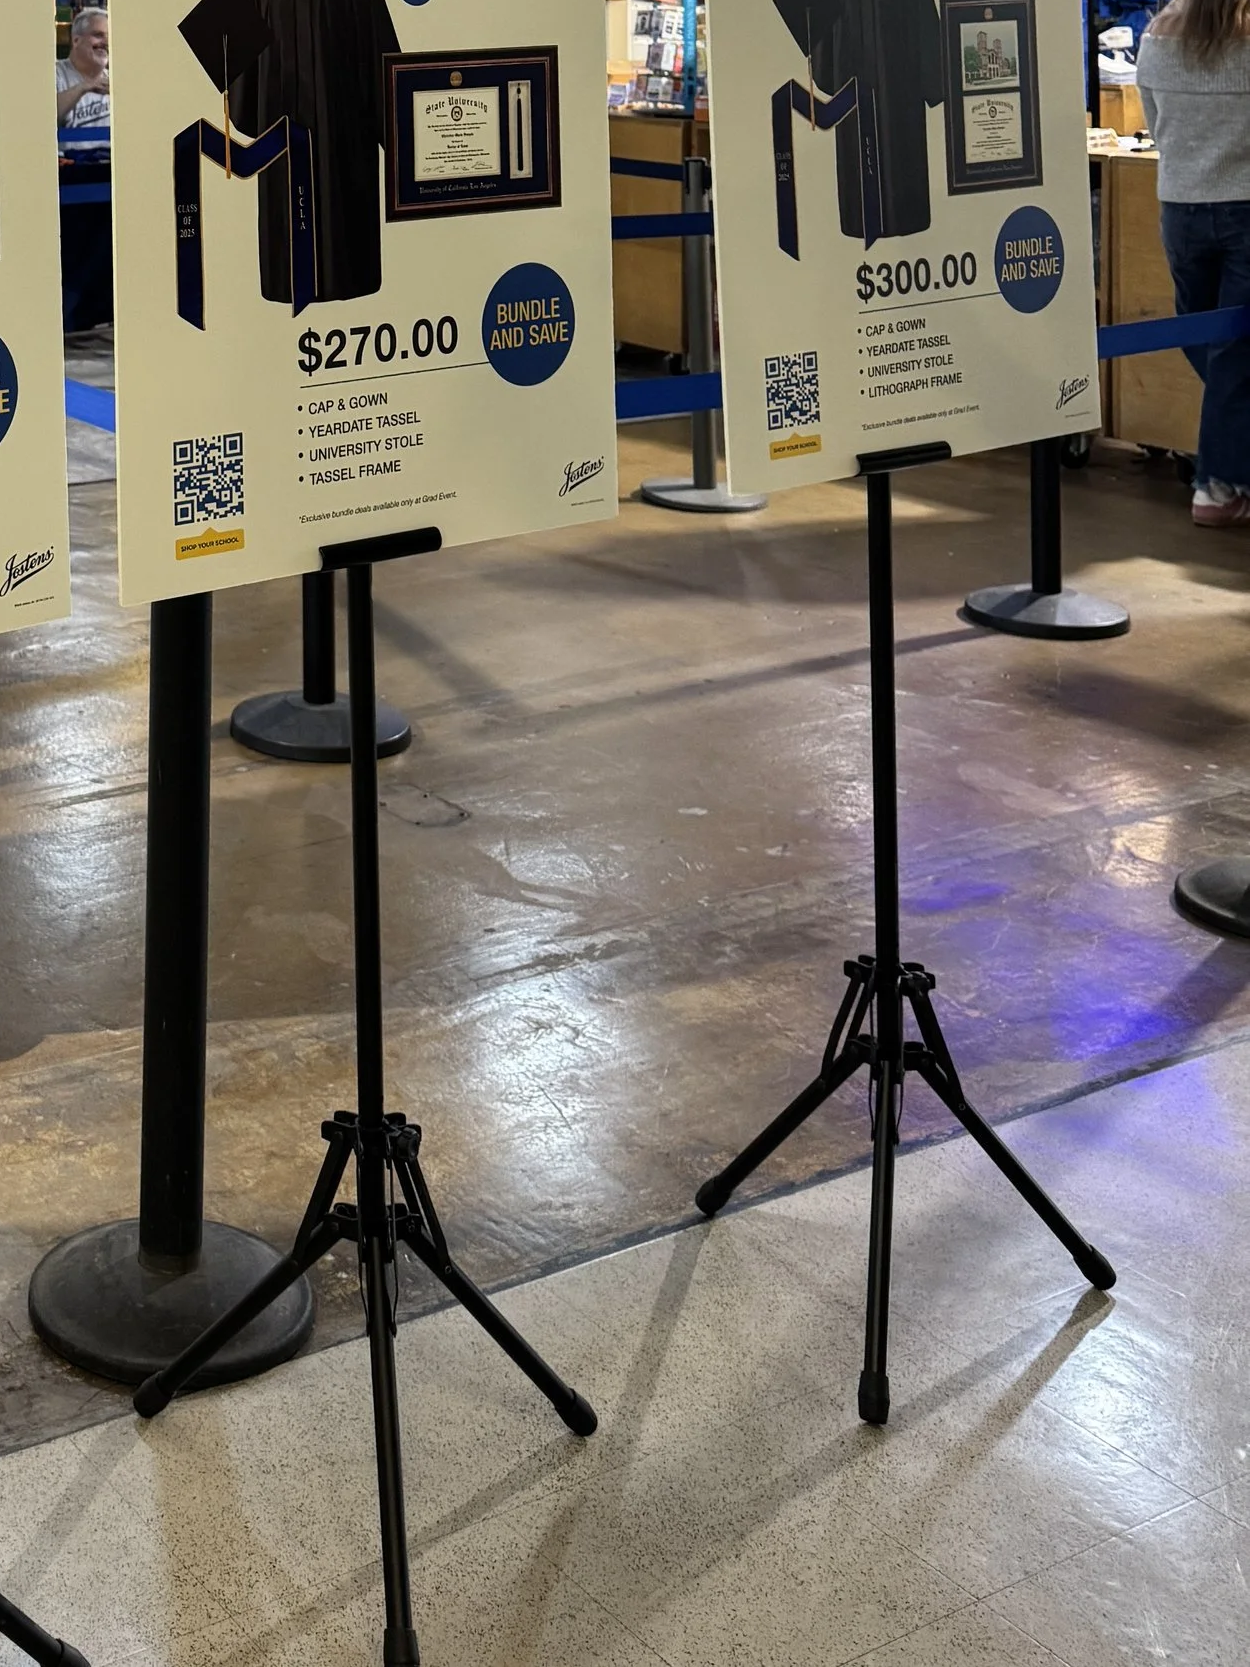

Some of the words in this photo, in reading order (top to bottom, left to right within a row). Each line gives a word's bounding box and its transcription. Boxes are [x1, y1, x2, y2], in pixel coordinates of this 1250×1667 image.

[177, 204, 198, 213] CLASS
[183, 216, 192, 225] OF
[298, 186, 306, 230] UCLA
[180, 229, 195, 238] 2025
[1005, 236, 1053, 259] BUNDLE
[856, 252, 977, 304] $300.00
[1001, 262, 1026, 282] AND
[1030, 257, 1060, 278] SAVE
[497, 297, 560, 324] BUNDLE
[490, 327, 524, 350] AND
[530, 321, 569, 345] SAVE
[866, 324, 885, 337] CAP
[887, 323, 894, 334] &
[896, 318, 926, 332] GOWN
[298, 316, 458, 377] $270.00
[866, 339, 915, 357] YEARDATE
[916, 335, 951, 349] TASSEL
[868, 359, 922, 378] UNIVERSITY
[924, 354, 954, 368] STOLE
[869, 378, 929, 398] LITHOGRAPH
[931, 372, 962, 387] FRAME
[308, 400, 334, 415] CAP
[337, 398, 346, 411] &
[349, 392, 388, 409] GOWN
[309, 418, 373, 438] YEARDATE
[376, 411, 421, 428] TASSEL
[310, 439, 382, 462] UNIVERSITY
[385, 433, 424, 450] STOLE
[309, 467, 356, 485] TASSEL
[359, 460, 401, 478] FRAME
[559, 455, 604, 497] Jostens
[332, 508, 353, 519] bundle
[355, 505, 371, 515] deals
[373, 500, 400, 512] available
[400, 498, 413, 507] only
[414, 496, 421, 504] at
[422, 493, 438, 503] Grad
[181, 544, 197, 552] SHOP
[198, 541, 215, 549] YOUR
[215, 536, 239, 546] SCHOOL
